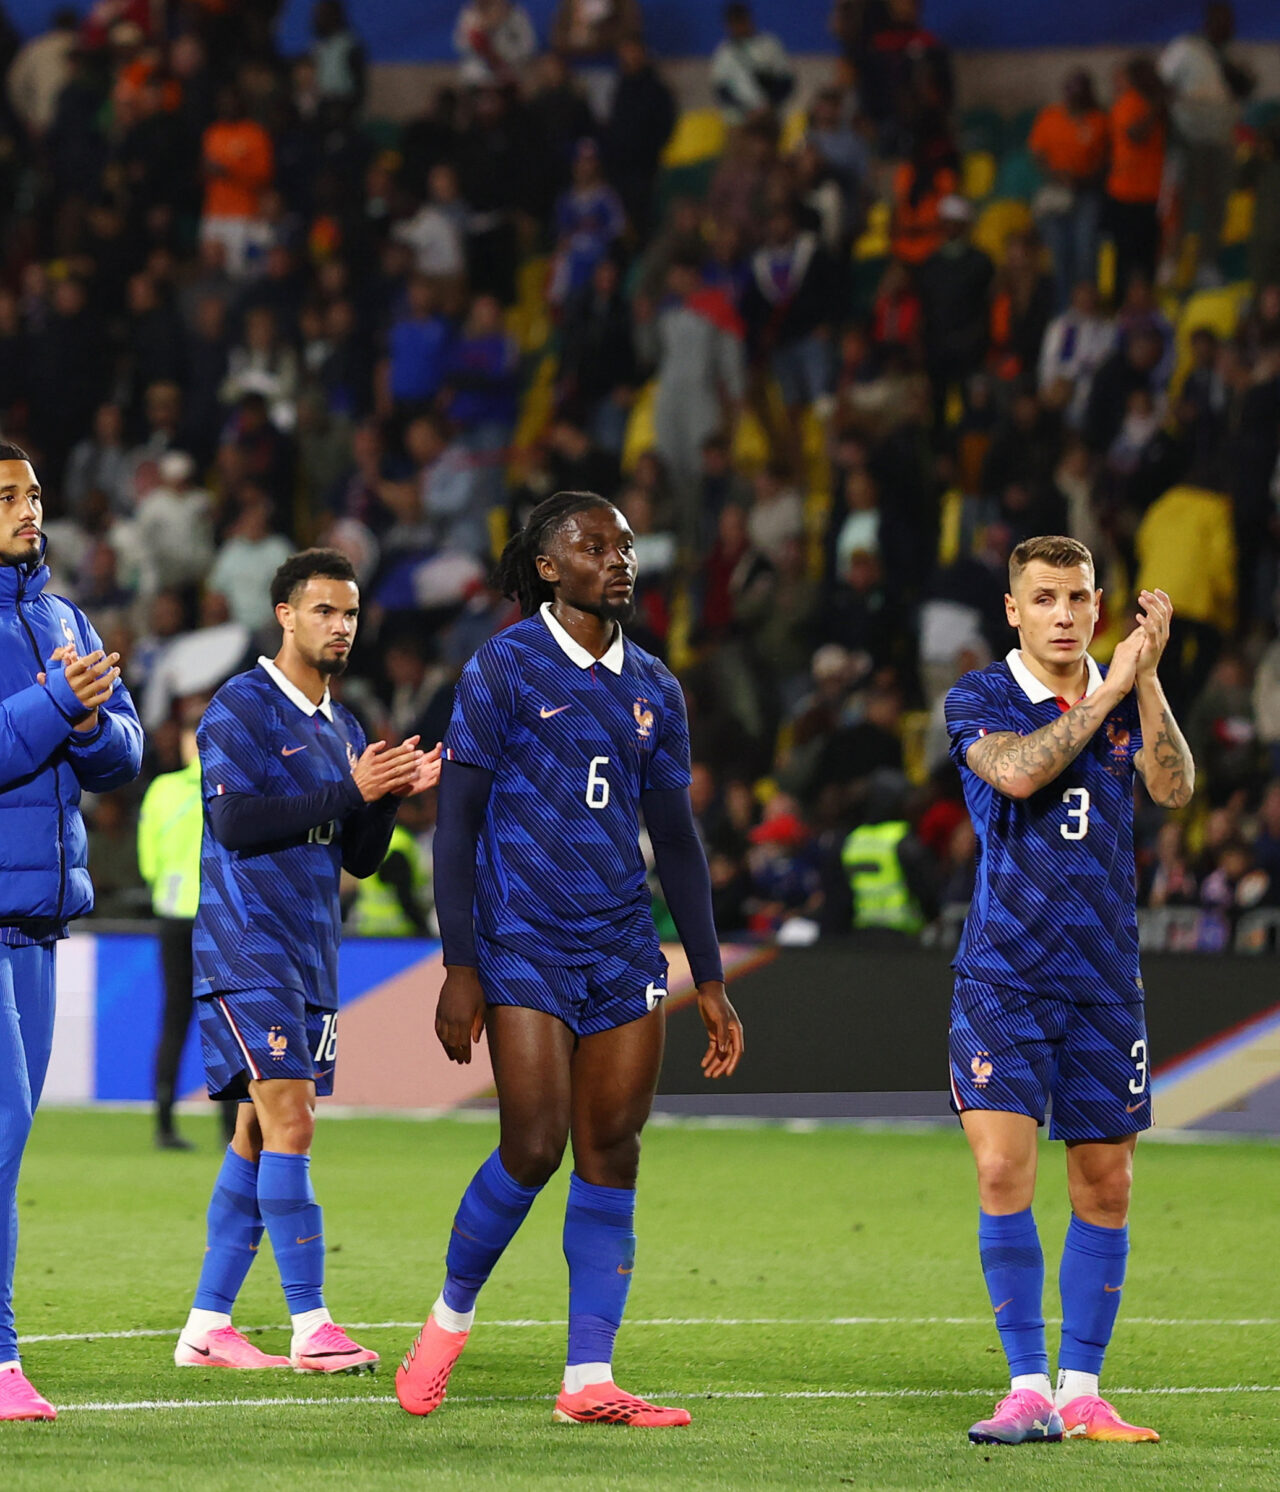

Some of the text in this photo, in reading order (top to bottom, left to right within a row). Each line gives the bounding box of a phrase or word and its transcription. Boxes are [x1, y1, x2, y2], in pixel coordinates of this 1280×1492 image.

[586, 756, 609, 808] 6
[1060, 787, 1090, 840] 3
[1128, 1039, 1147, 1094] 3
